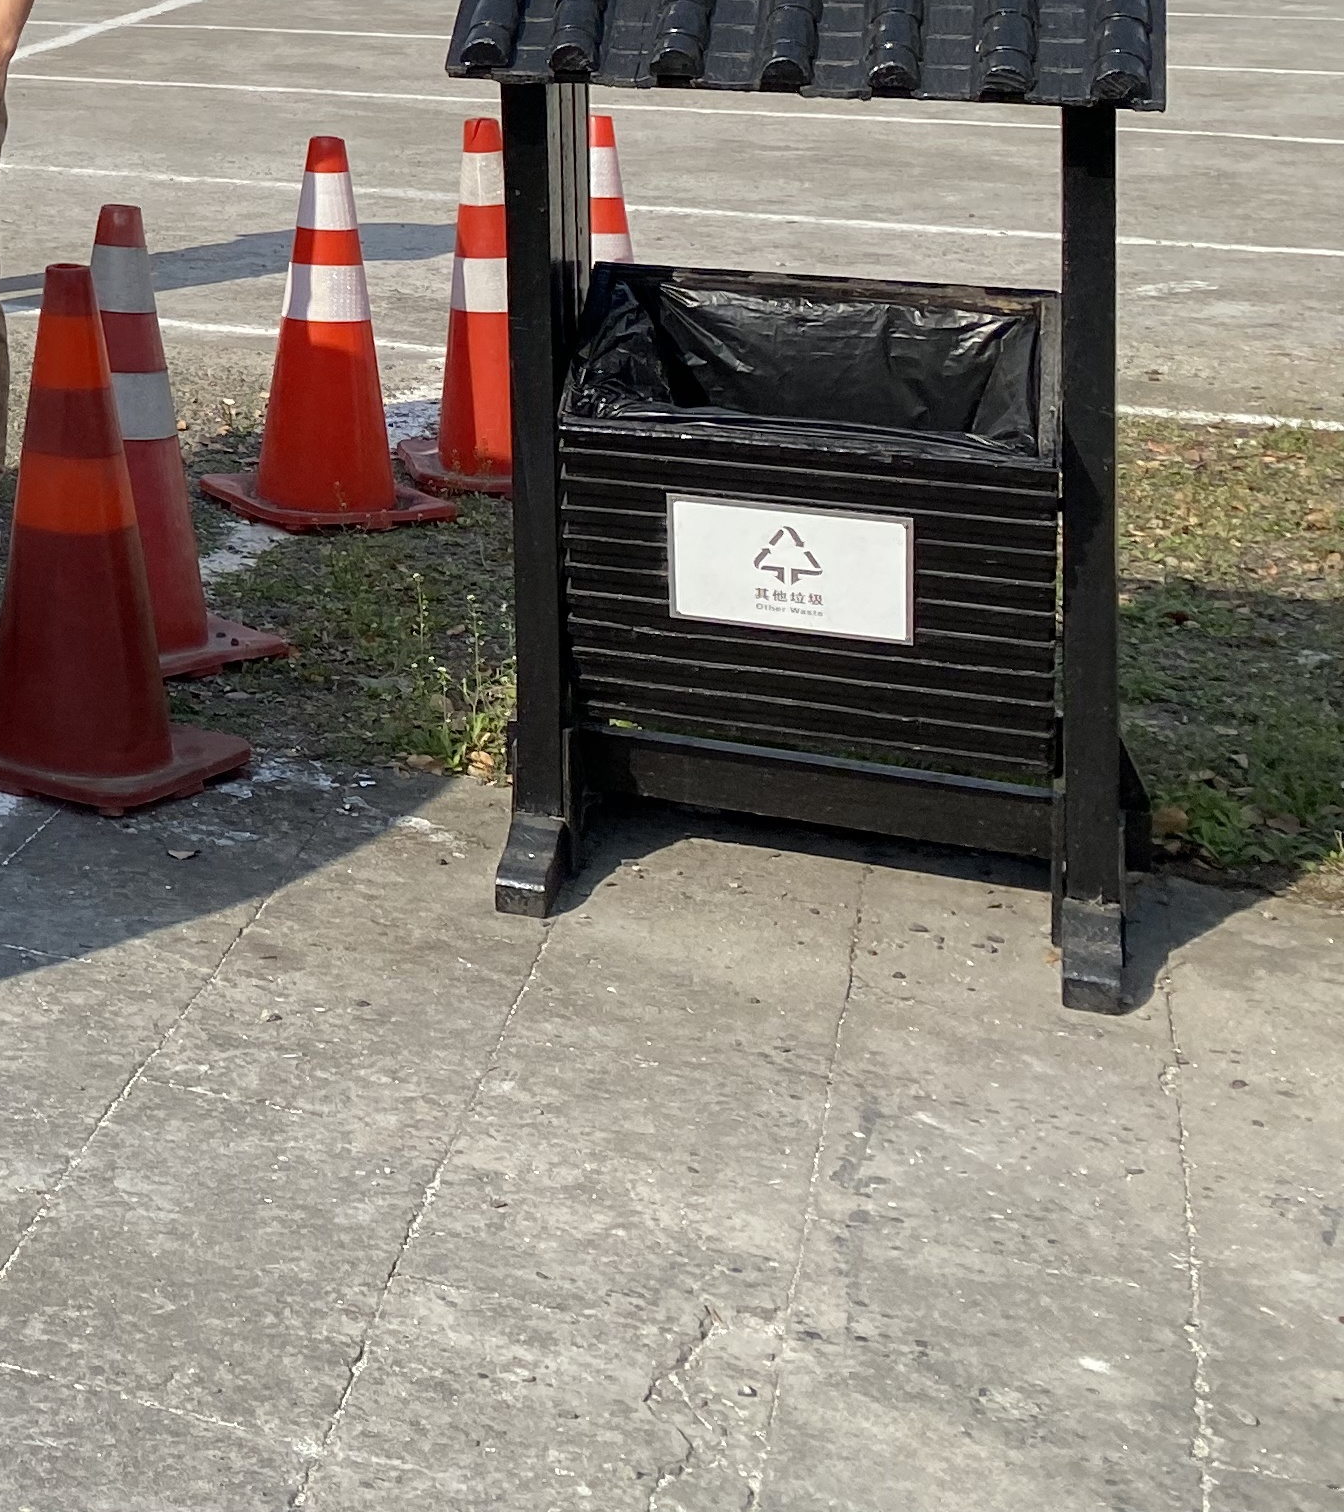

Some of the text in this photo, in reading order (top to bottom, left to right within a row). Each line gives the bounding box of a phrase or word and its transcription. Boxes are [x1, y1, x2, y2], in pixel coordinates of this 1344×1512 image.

[755, 588, 824, 606] 其他垃圾
[755, 603, 823, 617] Other Waste
